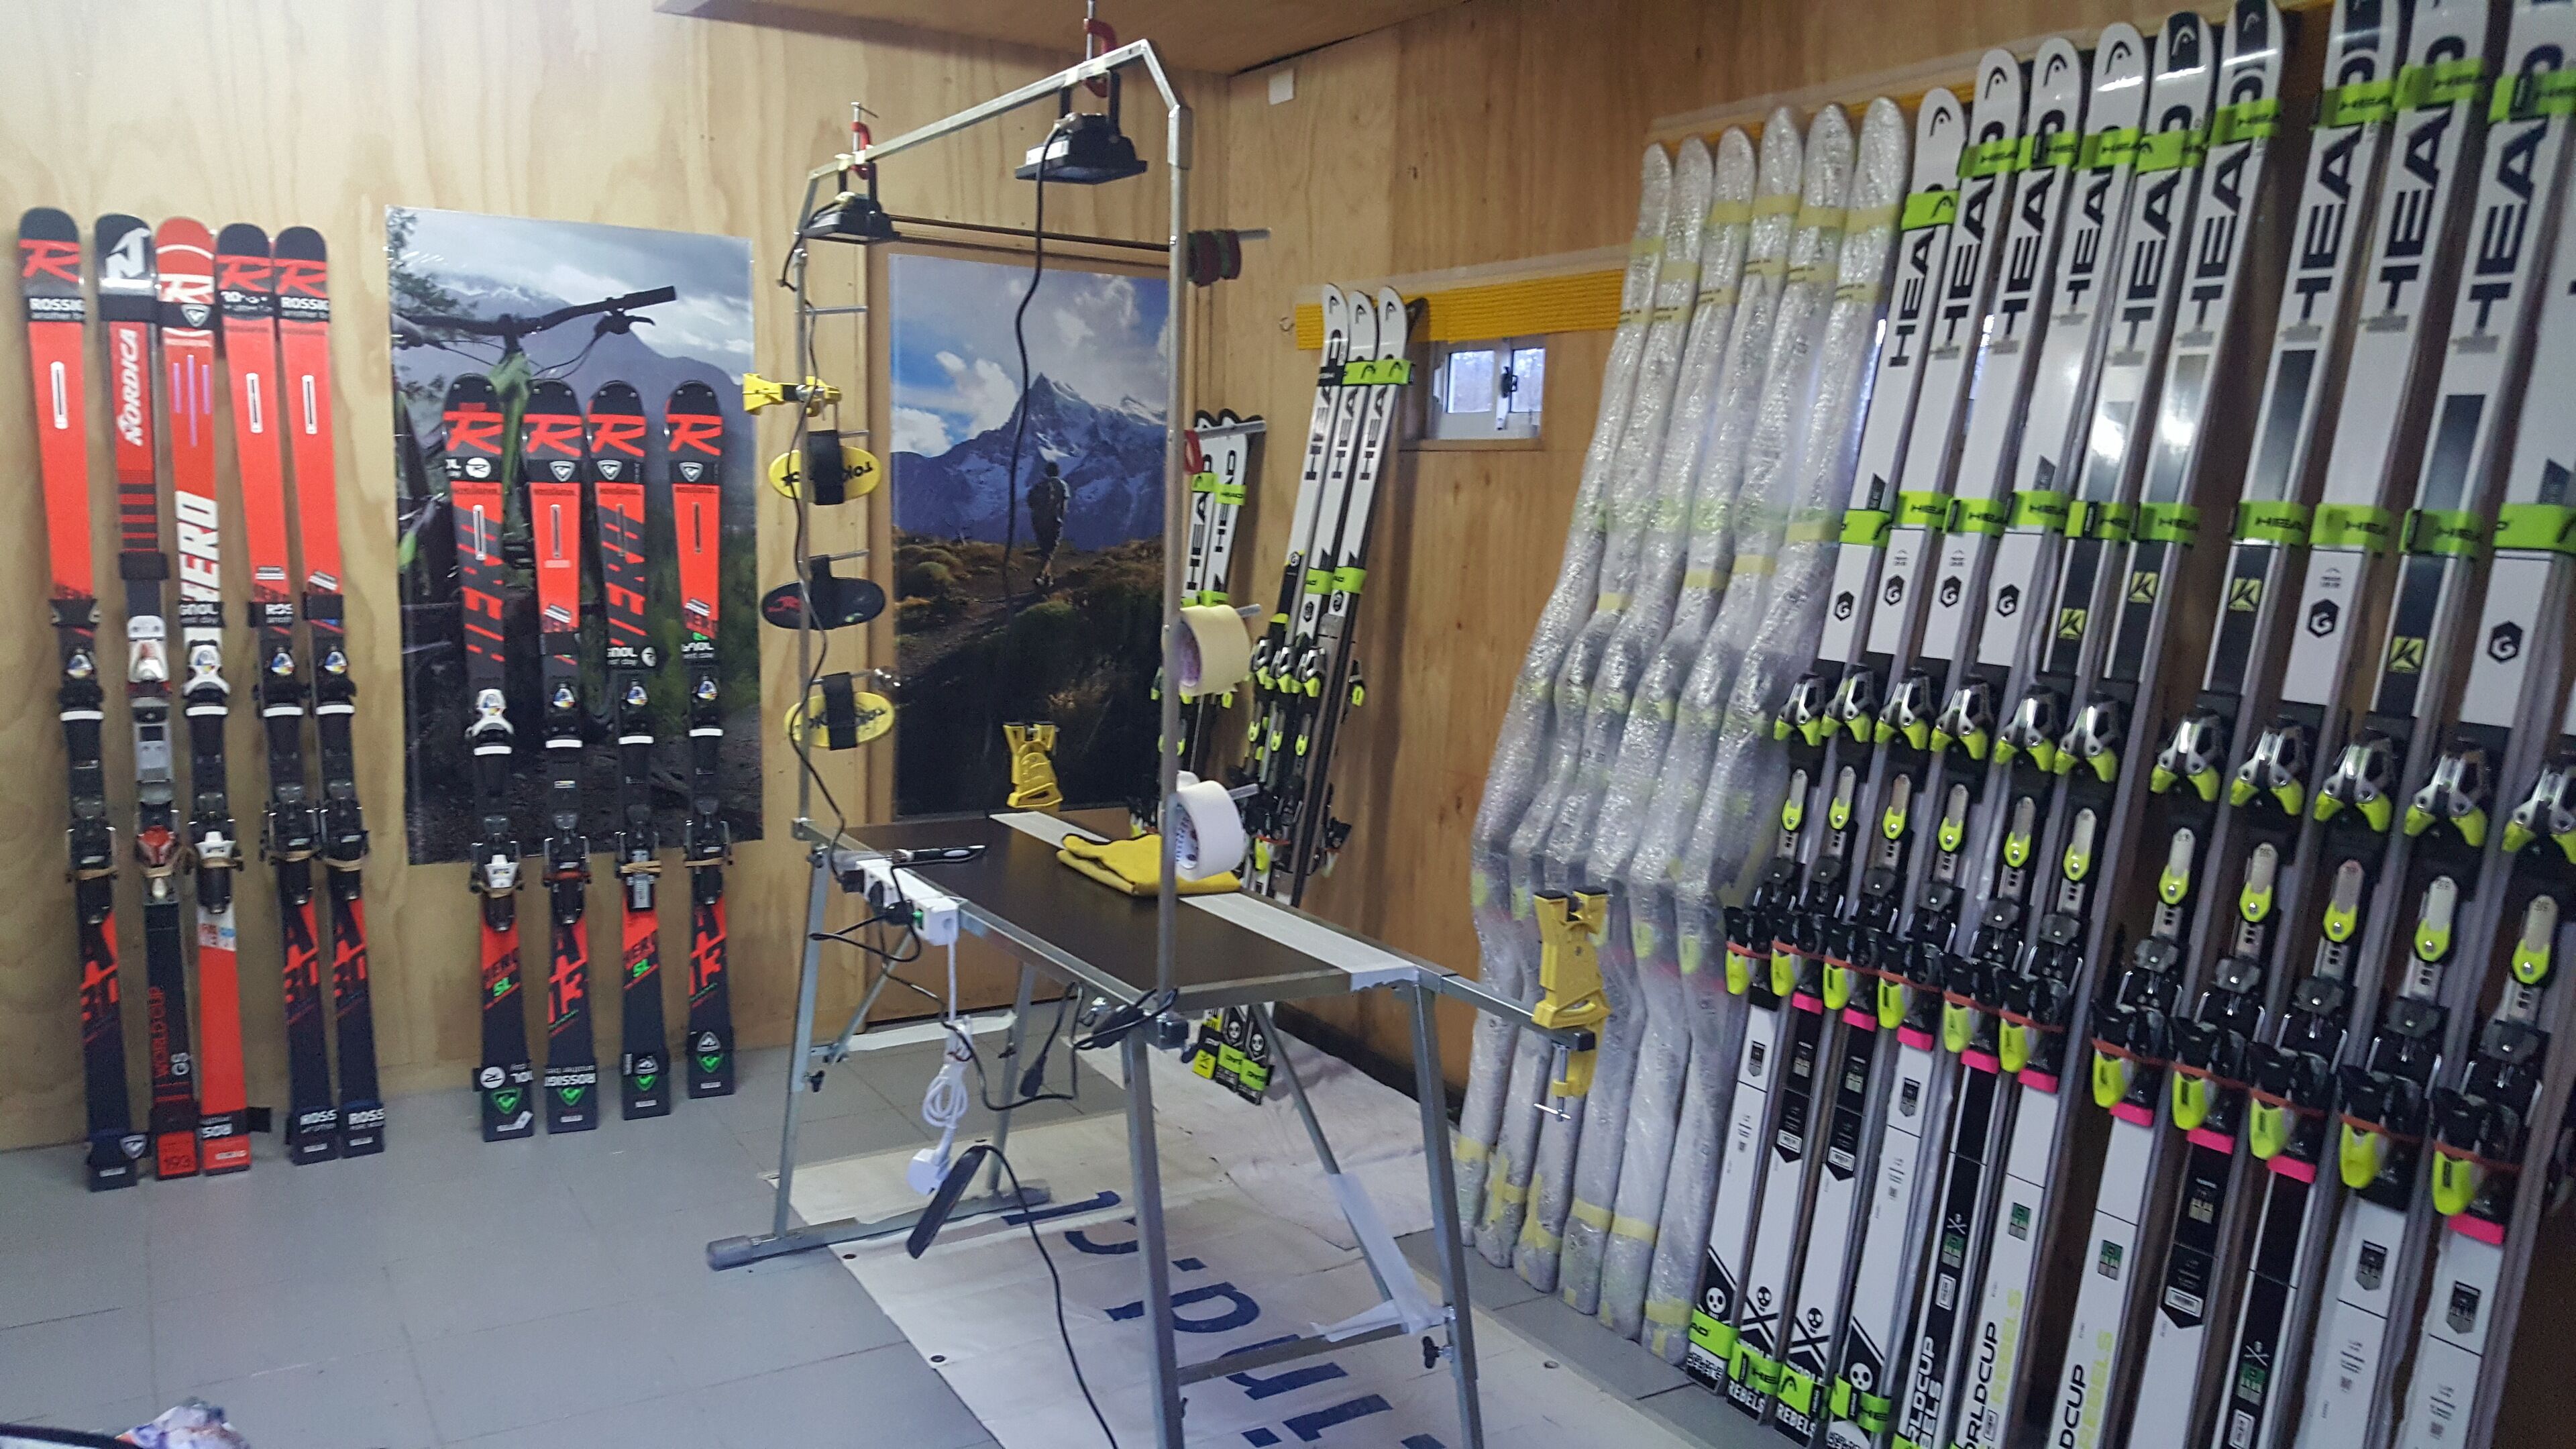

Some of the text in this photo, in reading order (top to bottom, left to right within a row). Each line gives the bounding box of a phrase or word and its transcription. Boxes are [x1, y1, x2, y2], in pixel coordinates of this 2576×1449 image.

[1889, 184, 1944, 367] HEA
[2053, 125, 2122, 325] HEA
[115, 329, 143, 447] NORDICA
[1330, 356, 1364, 479] HEA
[1359, 354, 1394, 480] HEA
